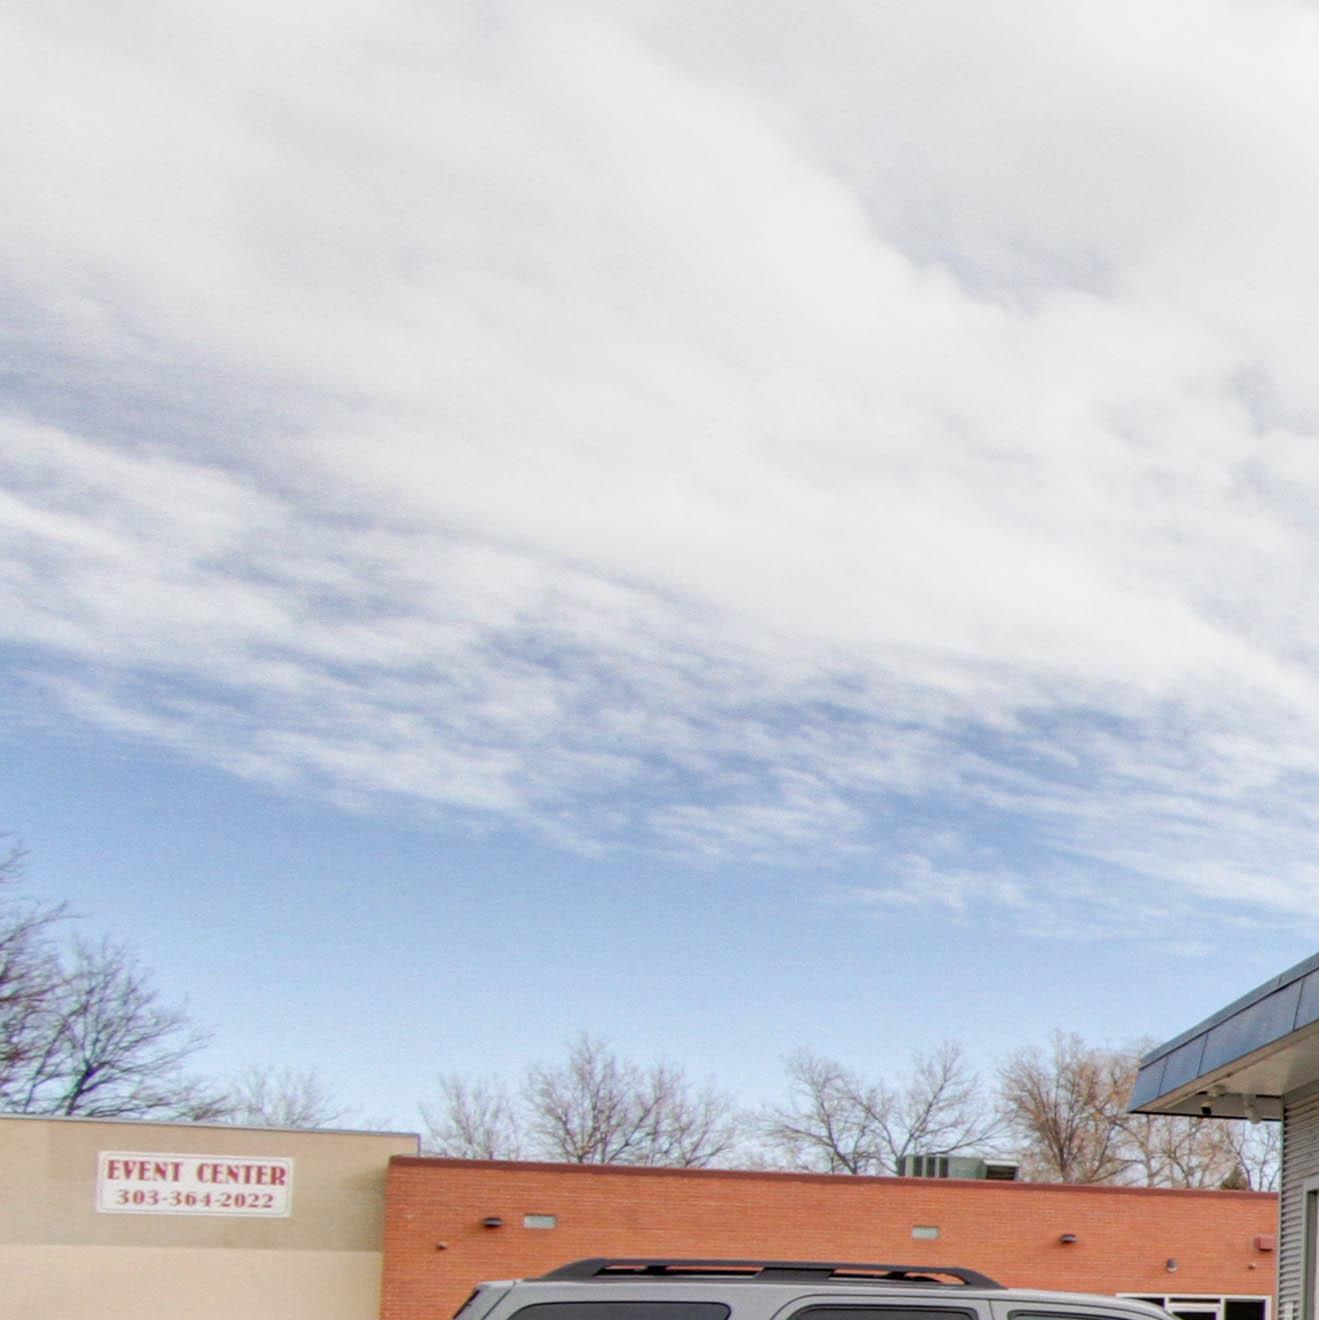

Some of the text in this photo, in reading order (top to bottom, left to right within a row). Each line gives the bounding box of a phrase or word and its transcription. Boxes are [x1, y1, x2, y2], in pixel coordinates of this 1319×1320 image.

[106, 1159, 286, 1186] EVENT CENTER
[115, 1188, 275, 1209] 303-364-2022
